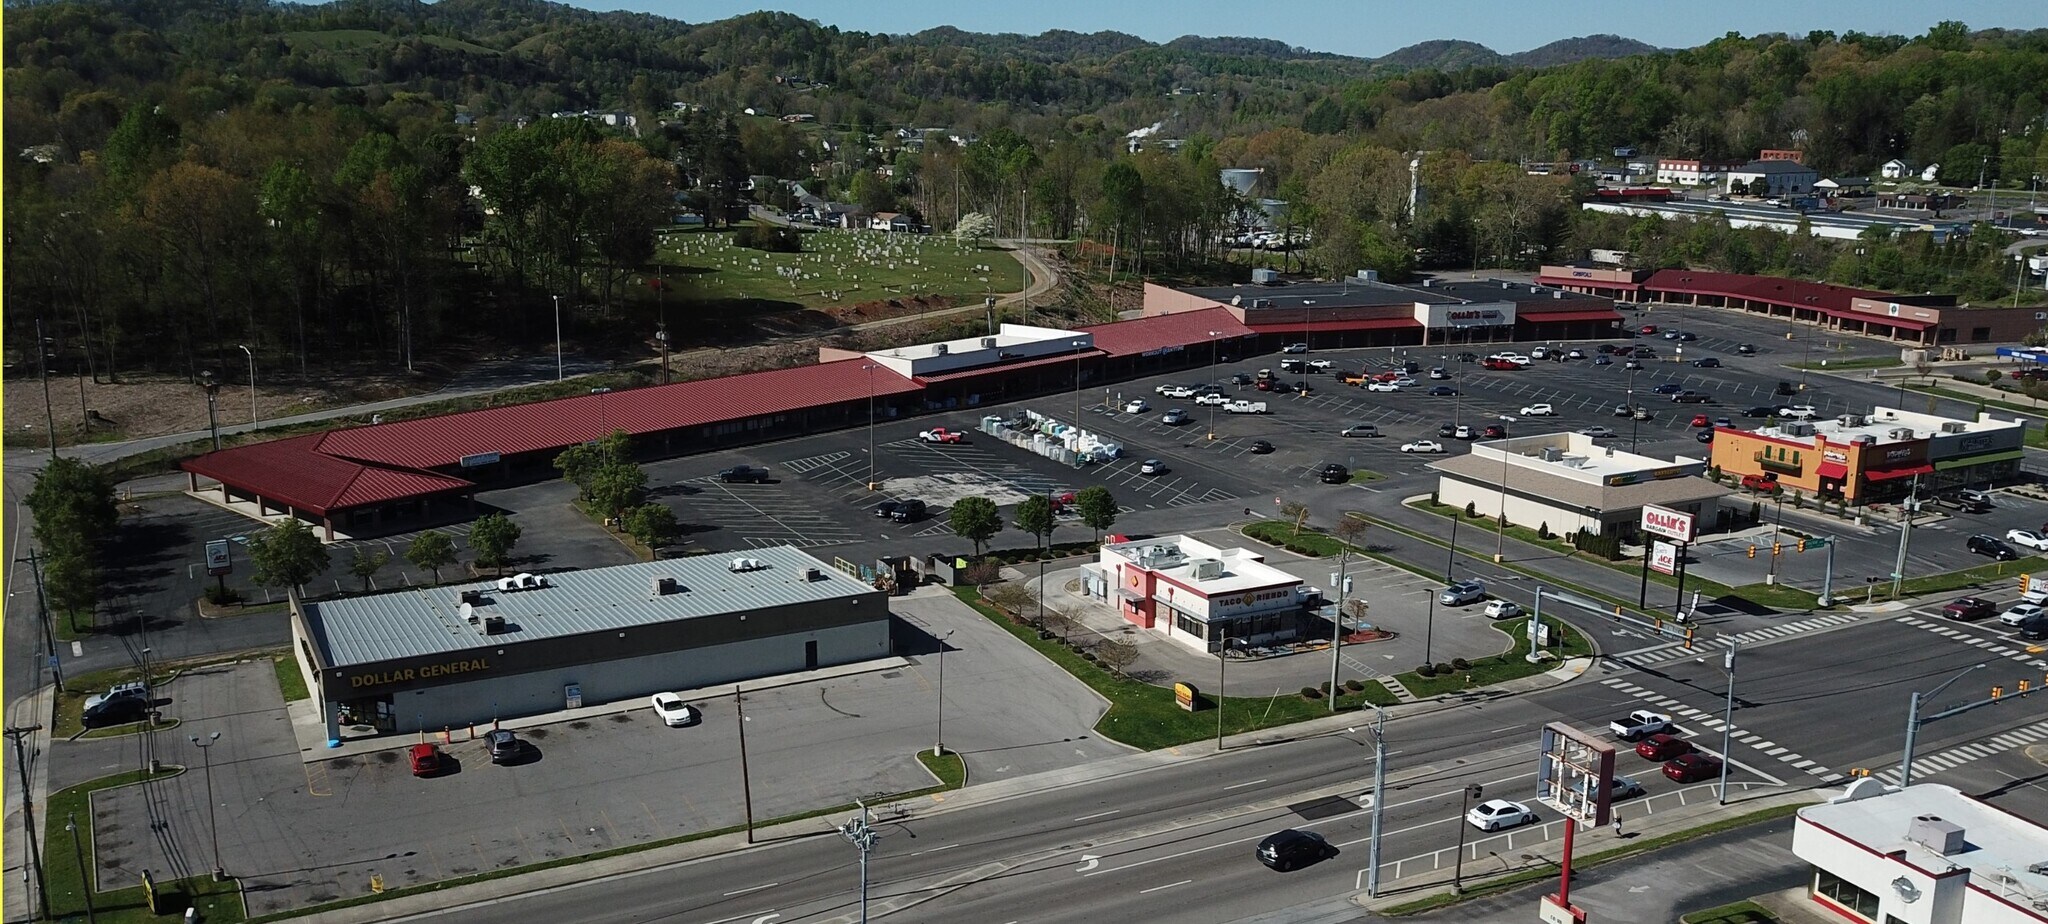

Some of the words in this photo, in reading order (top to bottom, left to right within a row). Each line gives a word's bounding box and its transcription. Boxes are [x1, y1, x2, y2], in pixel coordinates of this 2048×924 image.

[1646, 524, 1667, 534] BARGAIN
[1658, 555, 1674, 565] ACE
[1219, 598, 1242, 607] TACO
[1256, 590, 1289, 602] RIENDO
[350, 668, 415, 688] DOLLAR
[419, 658, 491, 678] GENERAL
